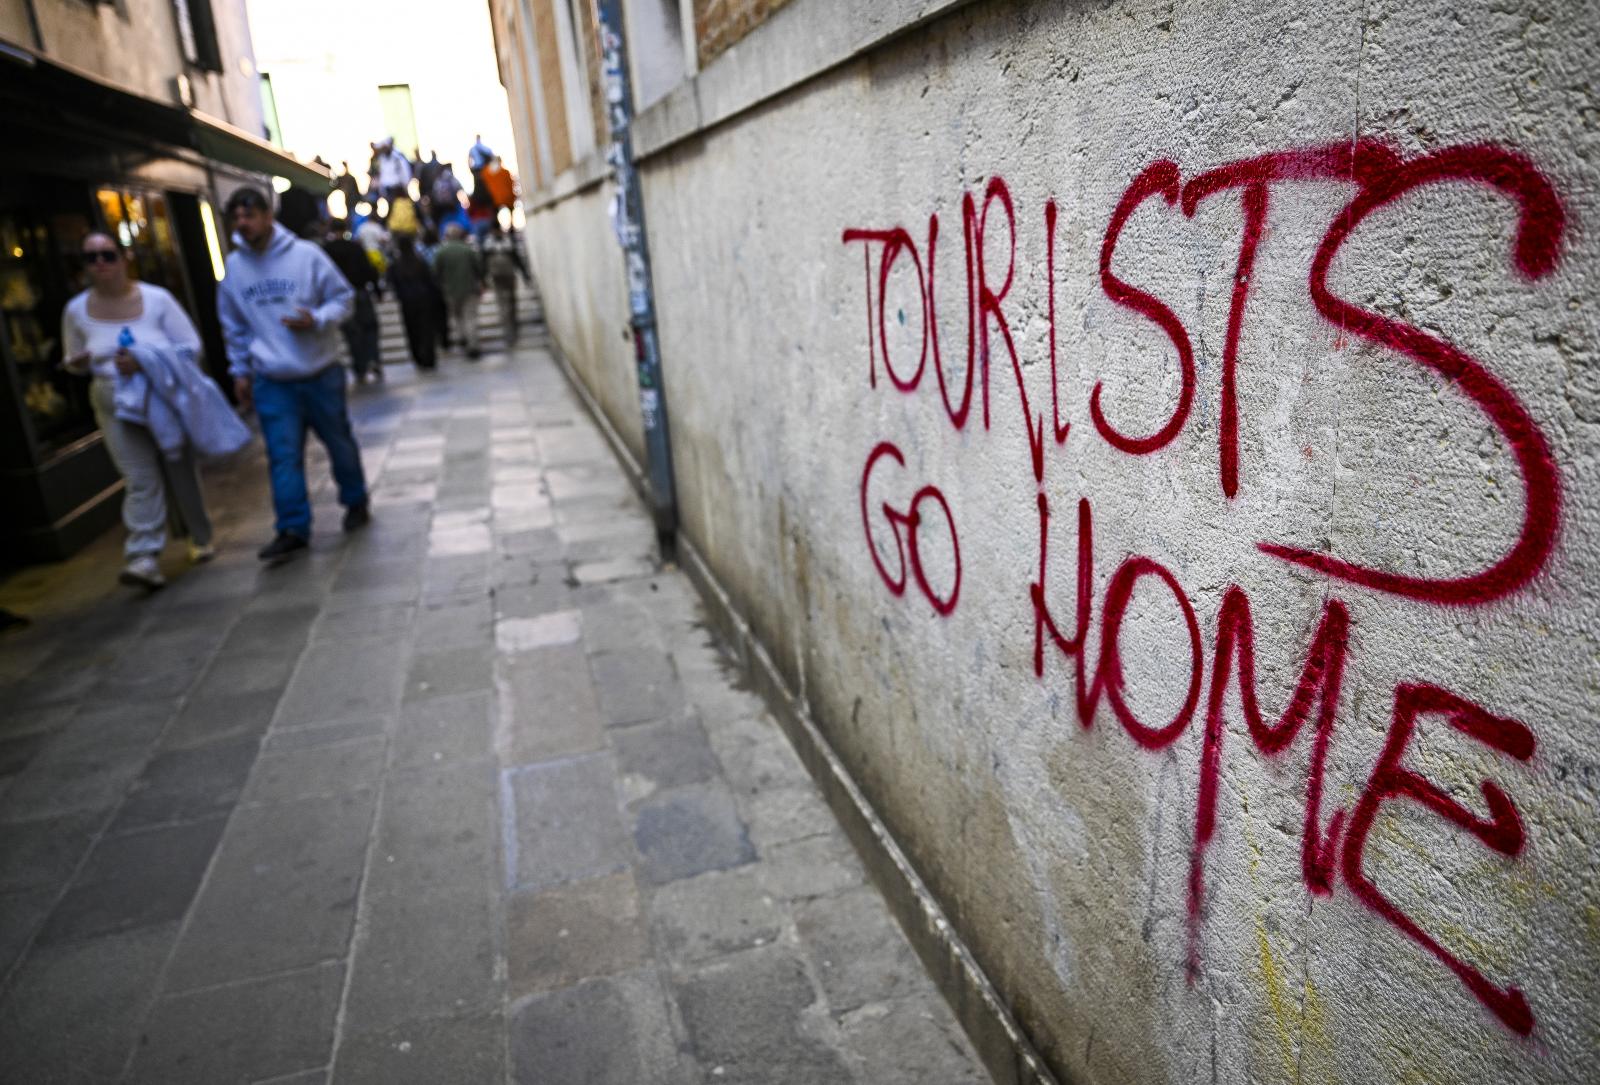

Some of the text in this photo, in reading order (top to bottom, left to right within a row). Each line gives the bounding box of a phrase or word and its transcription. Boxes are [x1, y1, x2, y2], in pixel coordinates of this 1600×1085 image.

[842, 134, 1567, 608] TOURISTS
[861, 441, 1537, 1038] GO HOME
